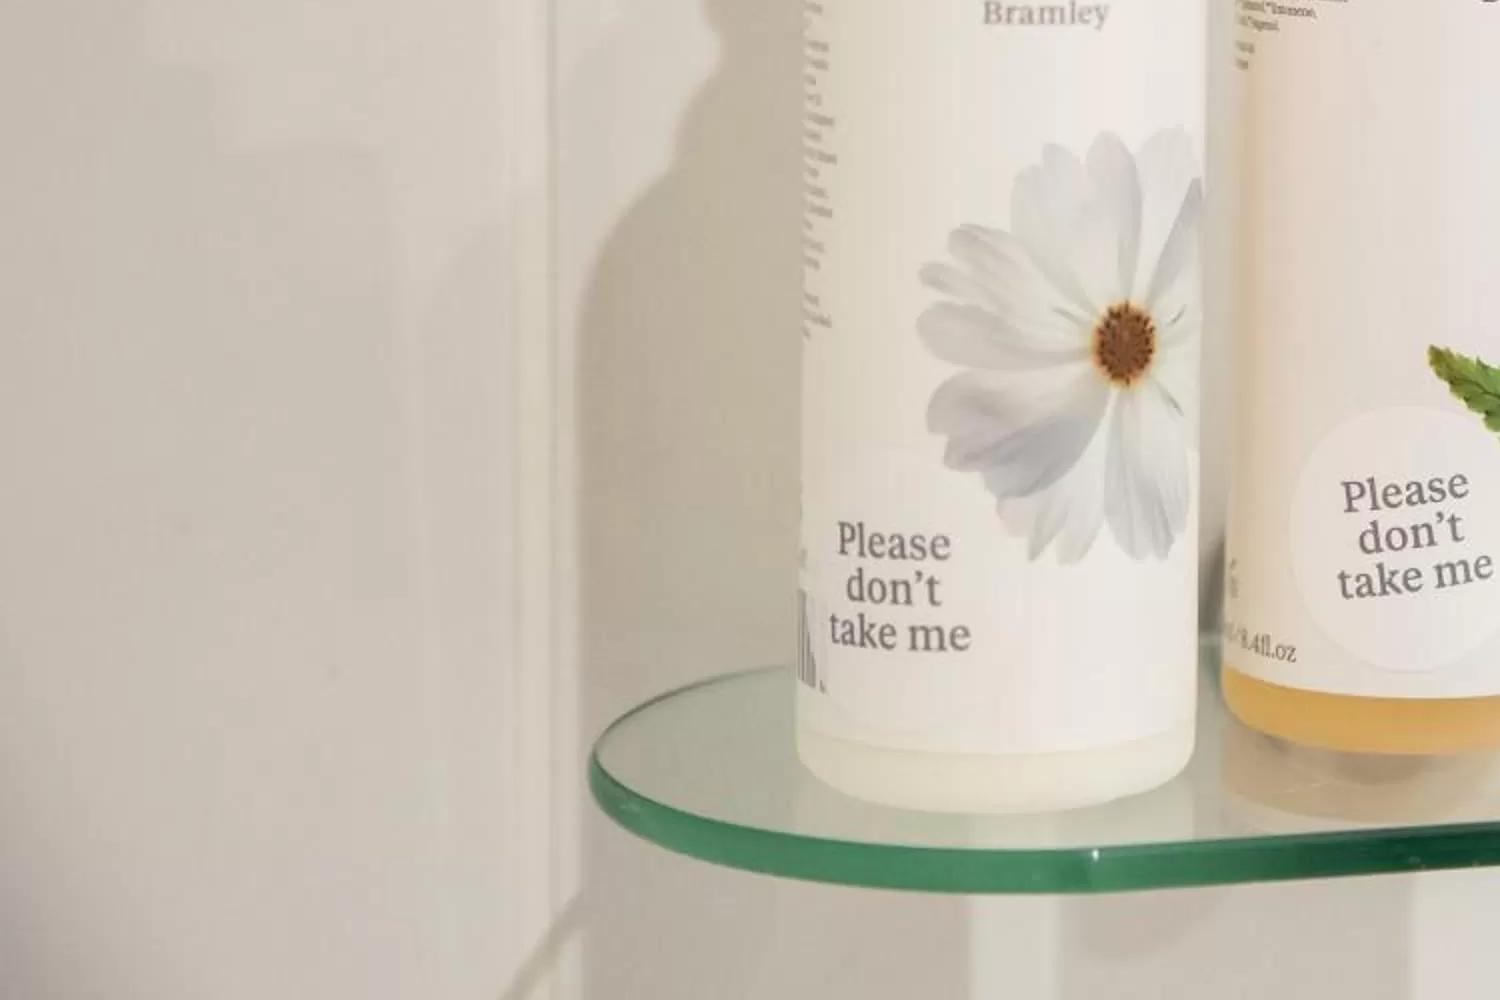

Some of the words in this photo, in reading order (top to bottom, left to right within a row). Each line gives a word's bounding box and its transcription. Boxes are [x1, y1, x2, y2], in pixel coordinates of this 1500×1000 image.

[983, 0, 1111, 31] Bramley
[1340, 473, 1470, 514] Please
[837, 520, 952, 562] Please
[1358, 511, 1466, 555] don’t
[846, 567, 943, 607] don’t
[1337, 562, 1424, 601] take
[1433, 554, 1494, 589] me
[829, 612, 897, 651] take
[907, 622, 972, 652] me
